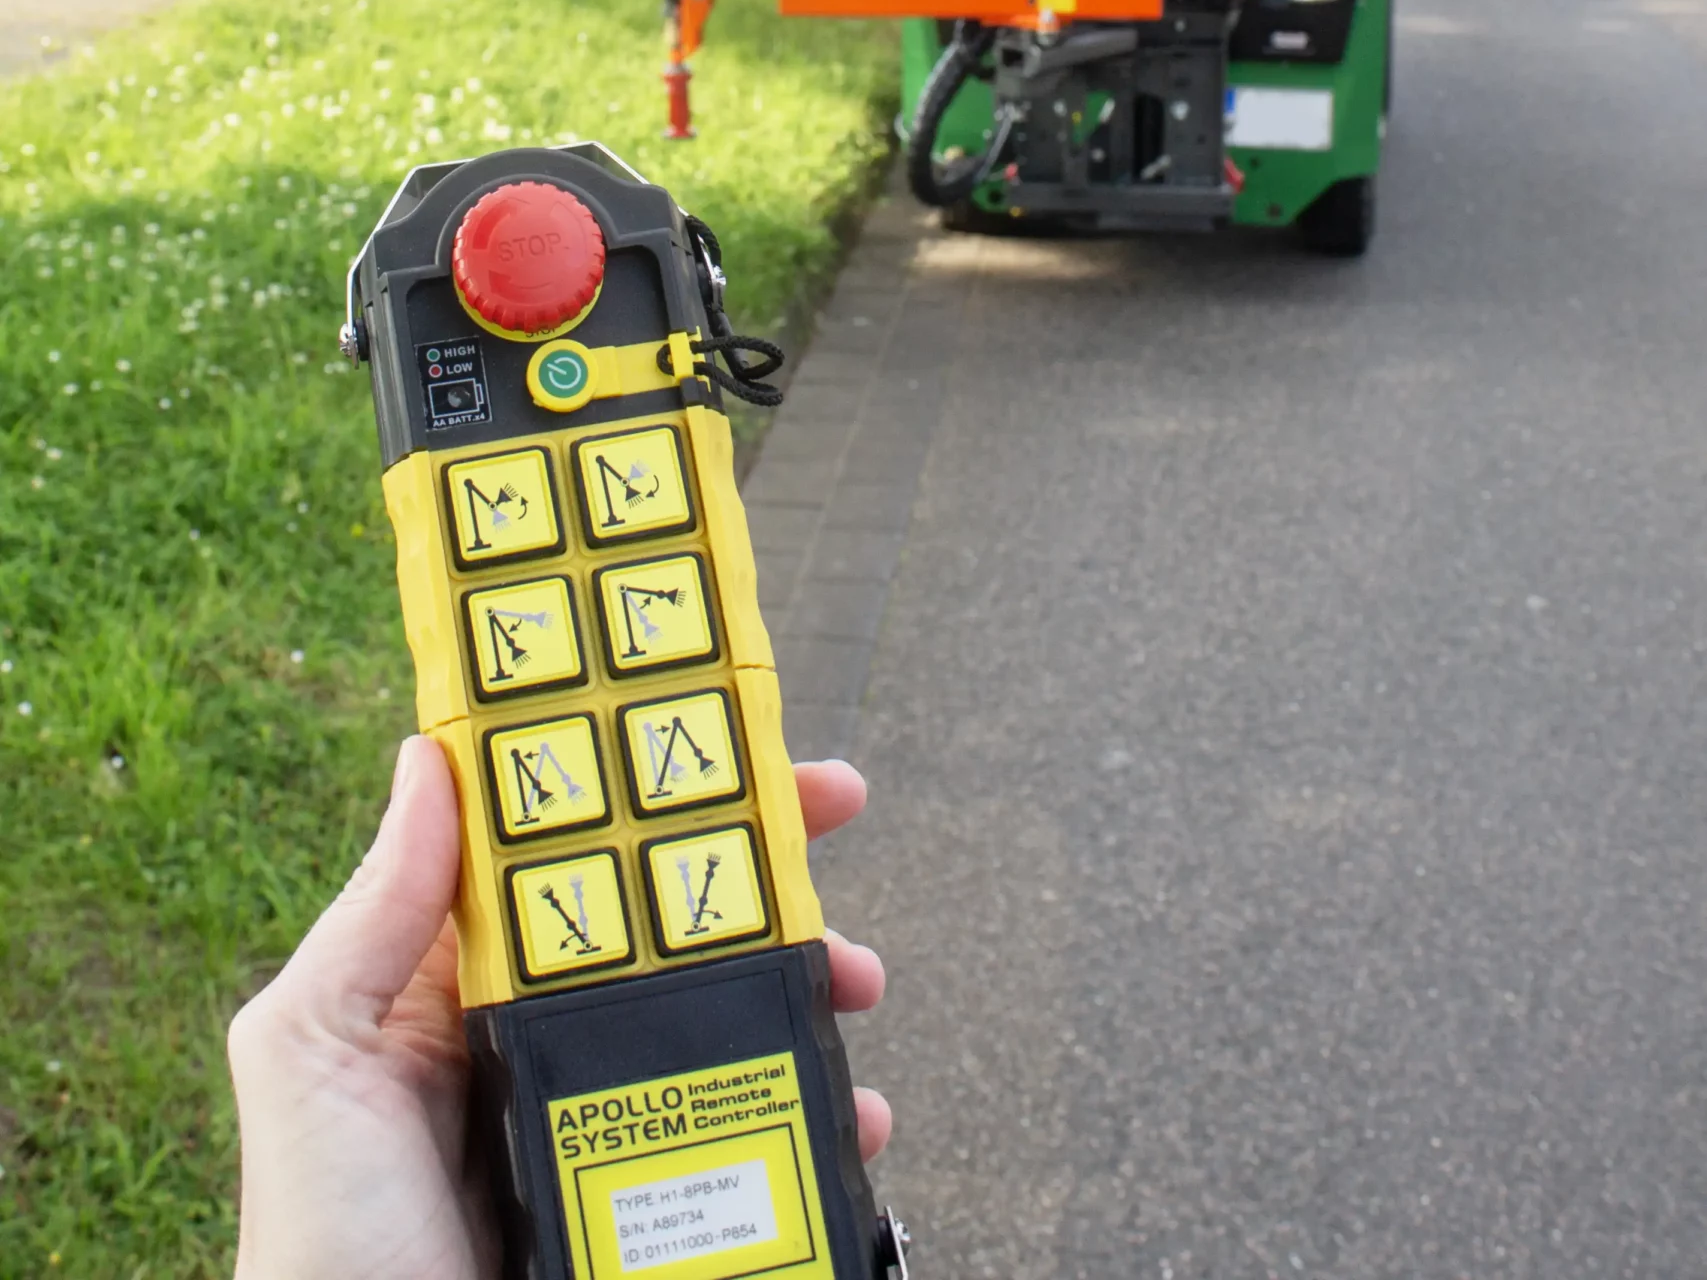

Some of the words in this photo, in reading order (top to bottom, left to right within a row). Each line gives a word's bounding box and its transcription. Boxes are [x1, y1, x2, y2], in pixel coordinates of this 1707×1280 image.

[499, 232, 562, 262] STOP
[443, 345, 476, 358] HIGH
[446, 362, 473, 375] LOW
[433, 419, 446, 428] AA
[688, 1064, 786, 1097] Industrial
[556, 1086, 684, 1134] APOLLO
[691, 1087, 772, 1113] Remote
[694, 1098, 800, 1131] Controller
[560, 1113, 688, 1160] SYSTEM
